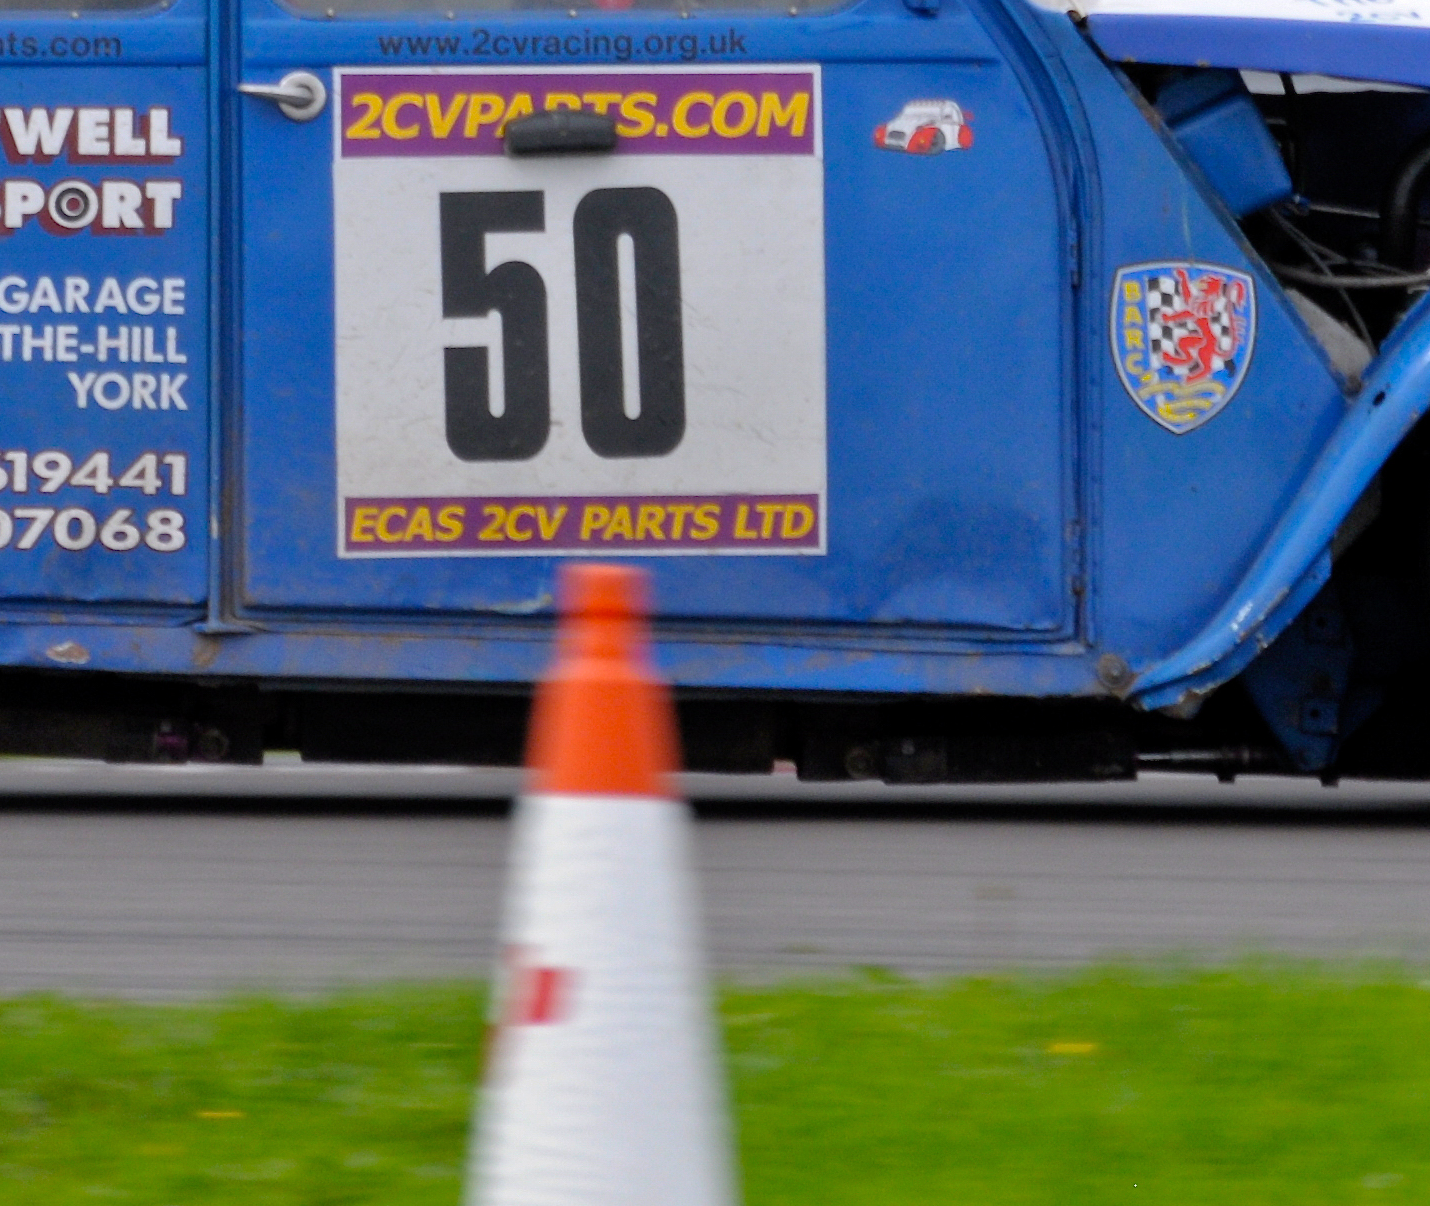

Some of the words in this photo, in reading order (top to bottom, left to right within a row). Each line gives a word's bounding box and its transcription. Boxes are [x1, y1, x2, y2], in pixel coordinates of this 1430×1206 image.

[378, 29, 748, 60] www.2cvracing.org.uk
[440, 186, 687, 462] 50
[1123, 280, 1145, 375] BARC
[68, 371, 189, 411] YORK
[350, 504, 466, 543] ECAS
[477, 504, 569, 542] 2CV
[579, 502, 721, 541] PARTS
[733, 502, 816, 539] LTD
